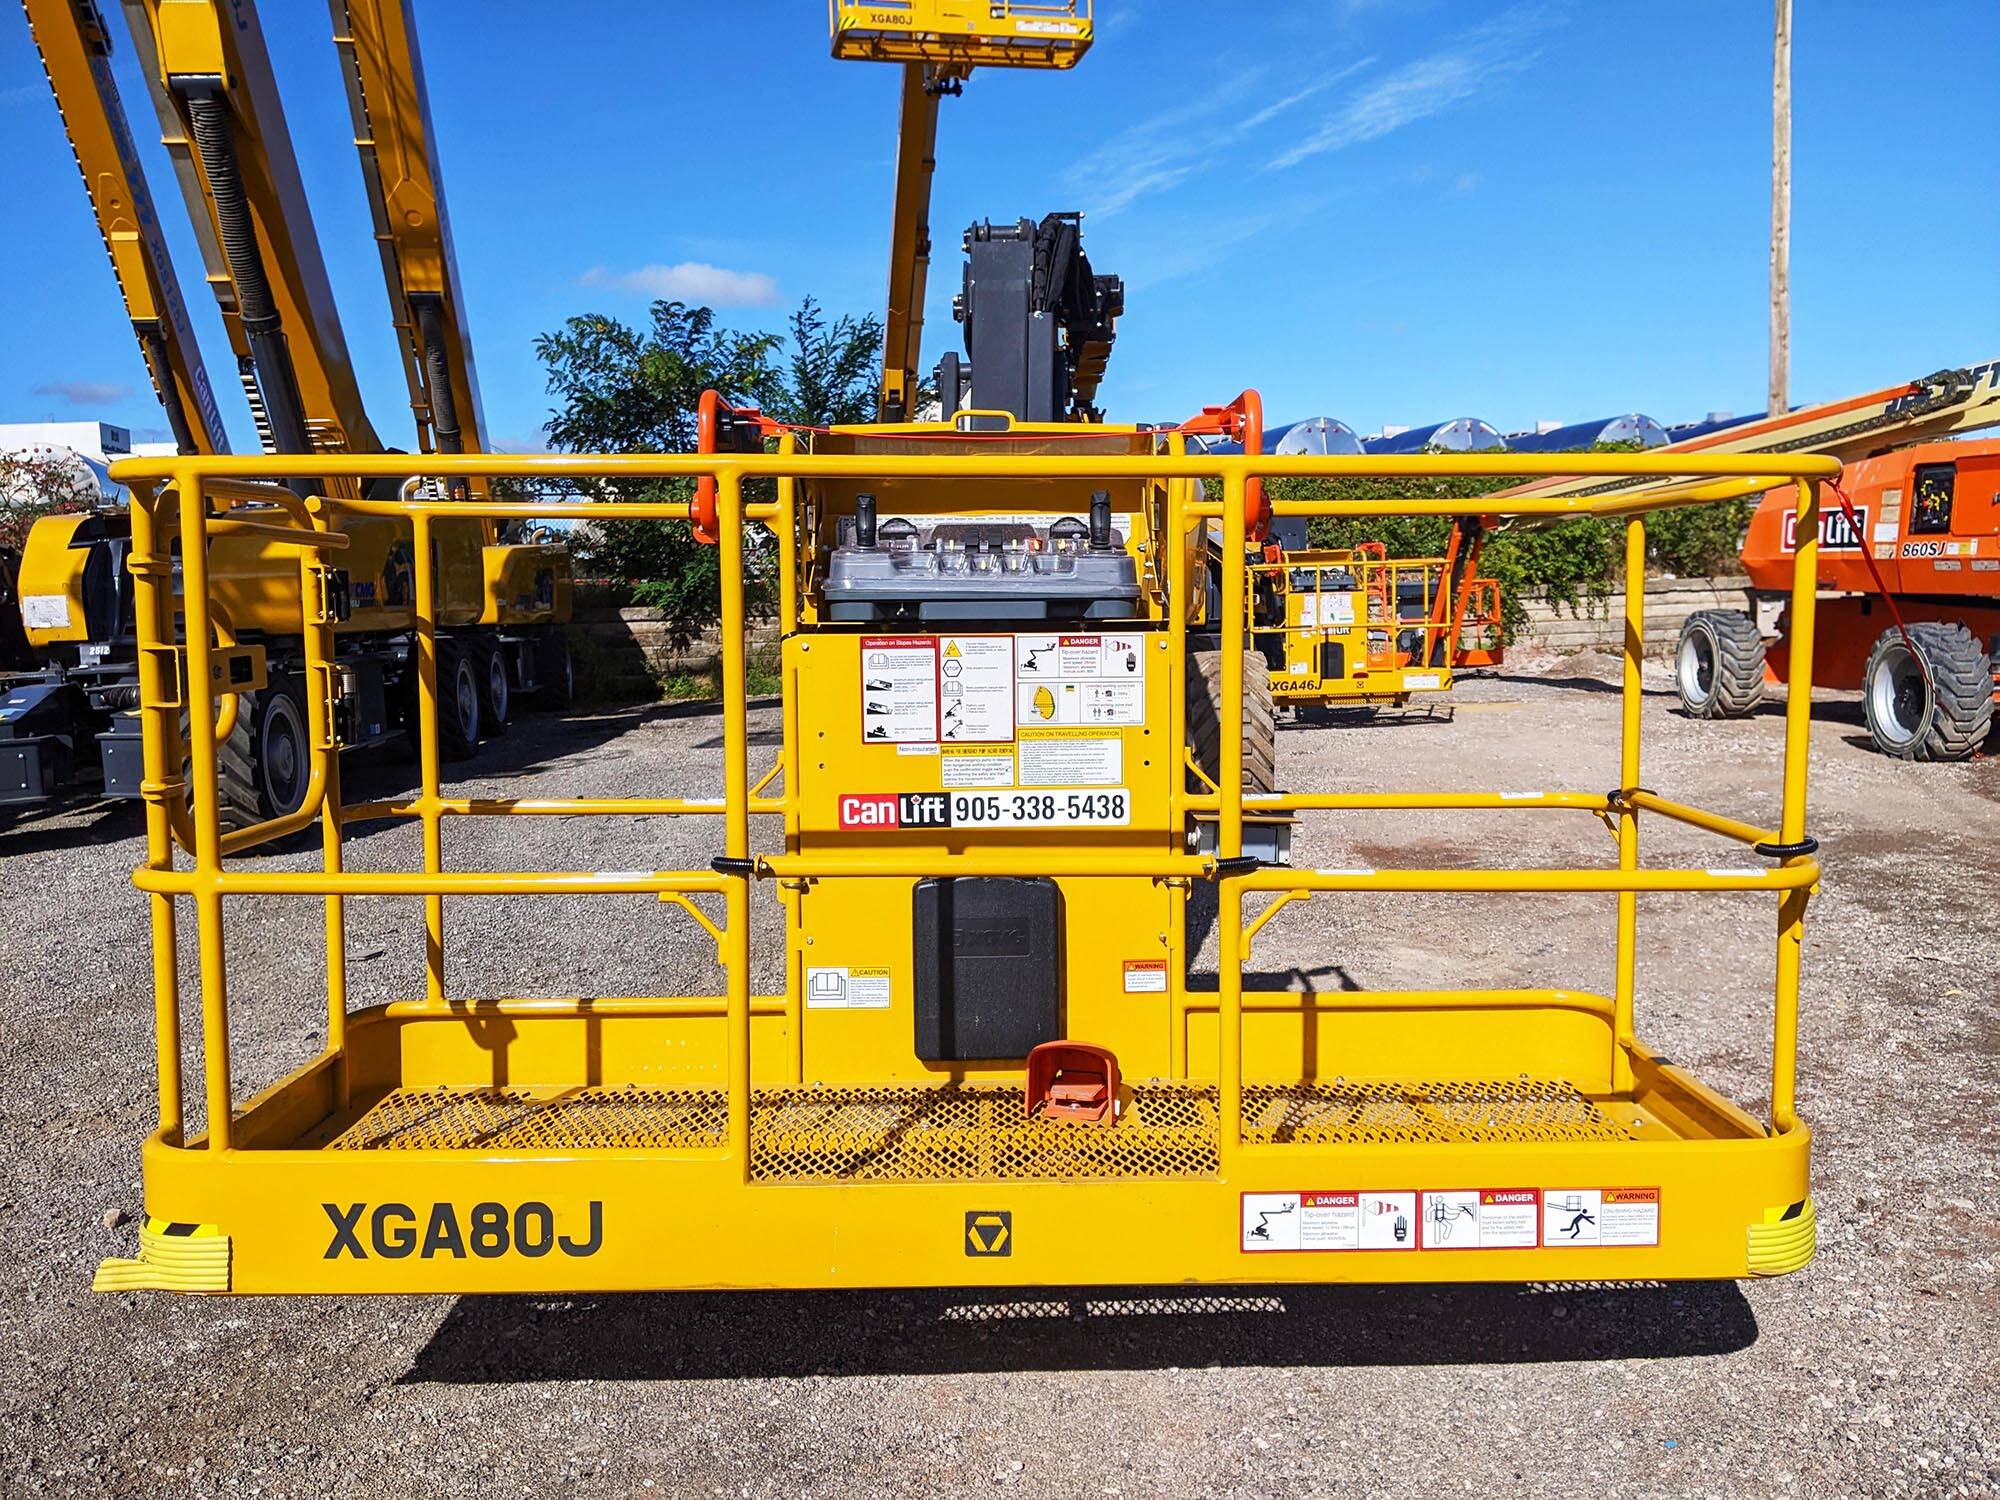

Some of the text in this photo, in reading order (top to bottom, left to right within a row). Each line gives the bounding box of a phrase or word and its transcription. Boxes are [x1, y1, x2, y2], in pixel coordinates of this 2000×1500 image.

[870, 13, 913, 25] XGA80J
[1901, 541, 1946, 557] 860SJ
[1272, 680, 1322, 692] XGA46J
[842, 794, 1125, 824] CanLift 905-338-5438
[1316, 1196, 1355, 1204] DANGER
[1496, 1194, 1534, 1202] DANGER
[1616, 1192, 1655, 1200] WARNING
[321, 1201, 603, 1259] XGA80J
